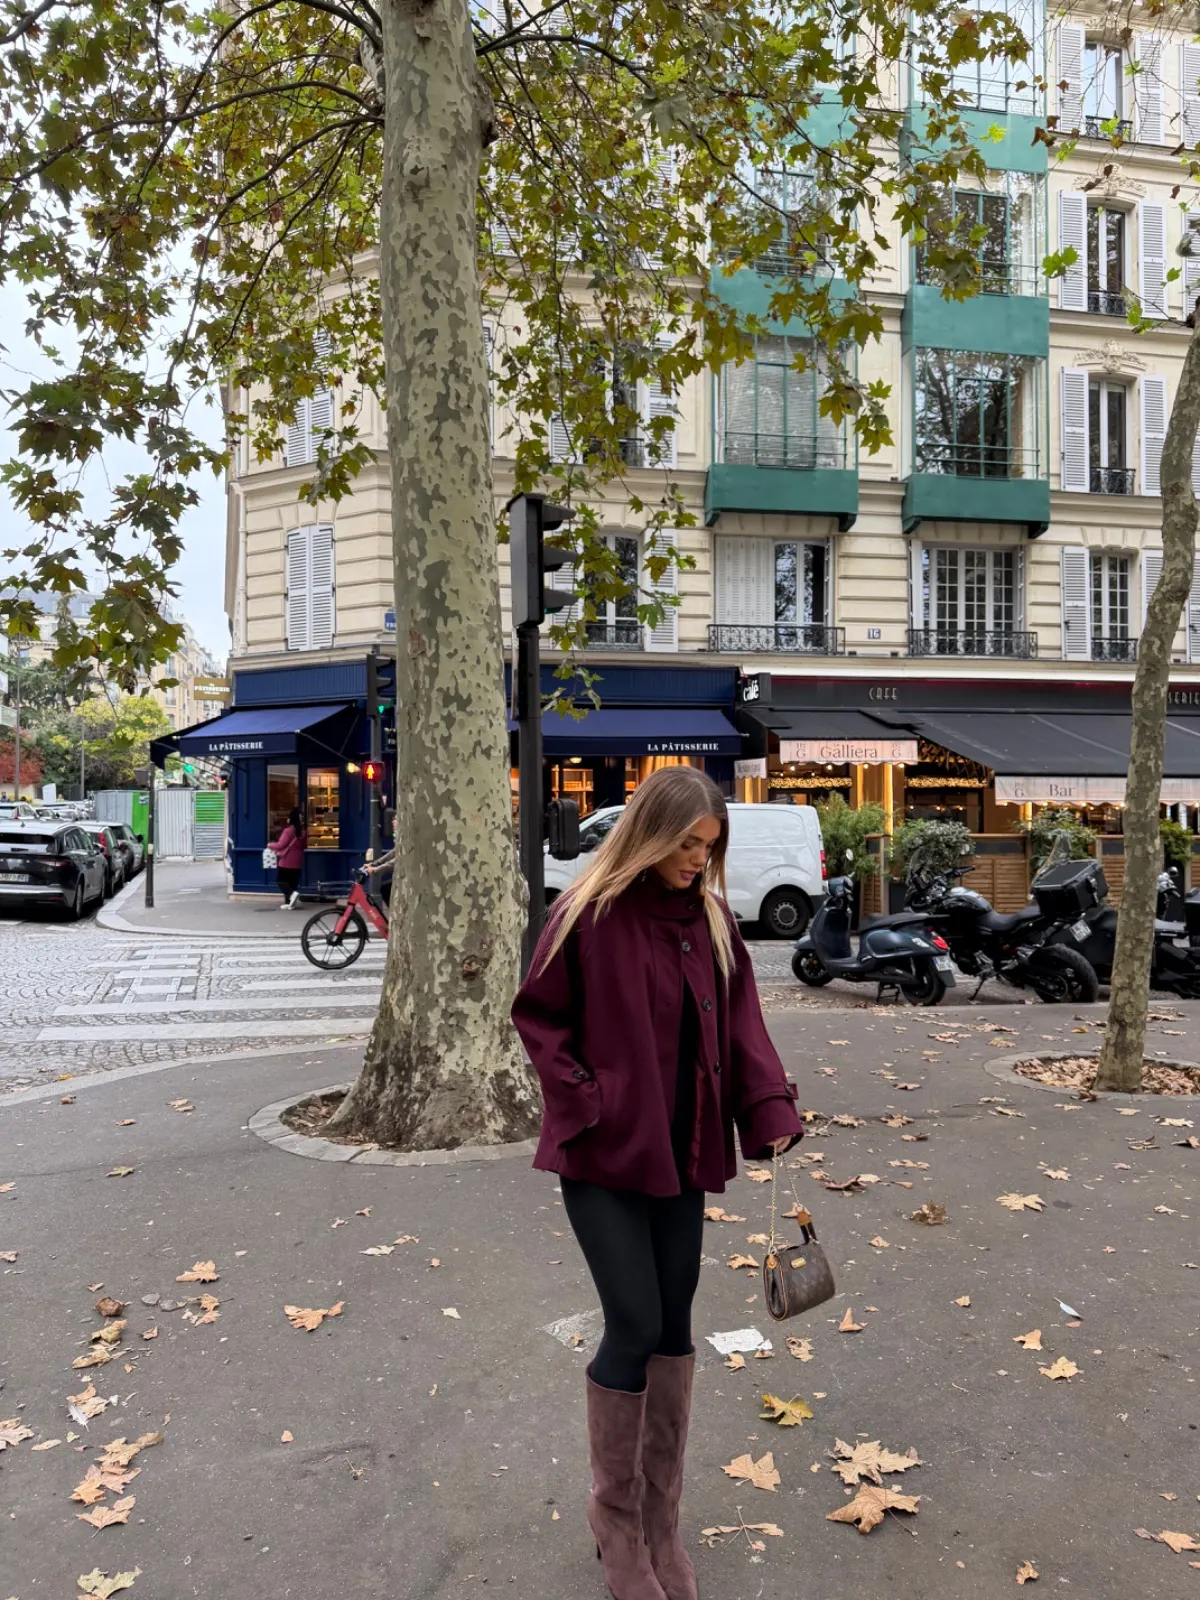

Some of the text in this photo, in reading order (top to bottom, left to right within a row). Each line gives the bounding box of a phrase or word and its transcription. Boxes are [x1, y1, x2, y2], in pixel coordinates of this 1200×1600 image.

[870, 628, 881, 639] 16
[743, 679, 759, 702] café
[209, 741, 264, 751] LA PÂTISSERIE
[647, 742, 719, 751] LA PÂTISSERIE
[820, 744, 878, 759] Galliera
[1049, 783, 1076, 797] Bar
